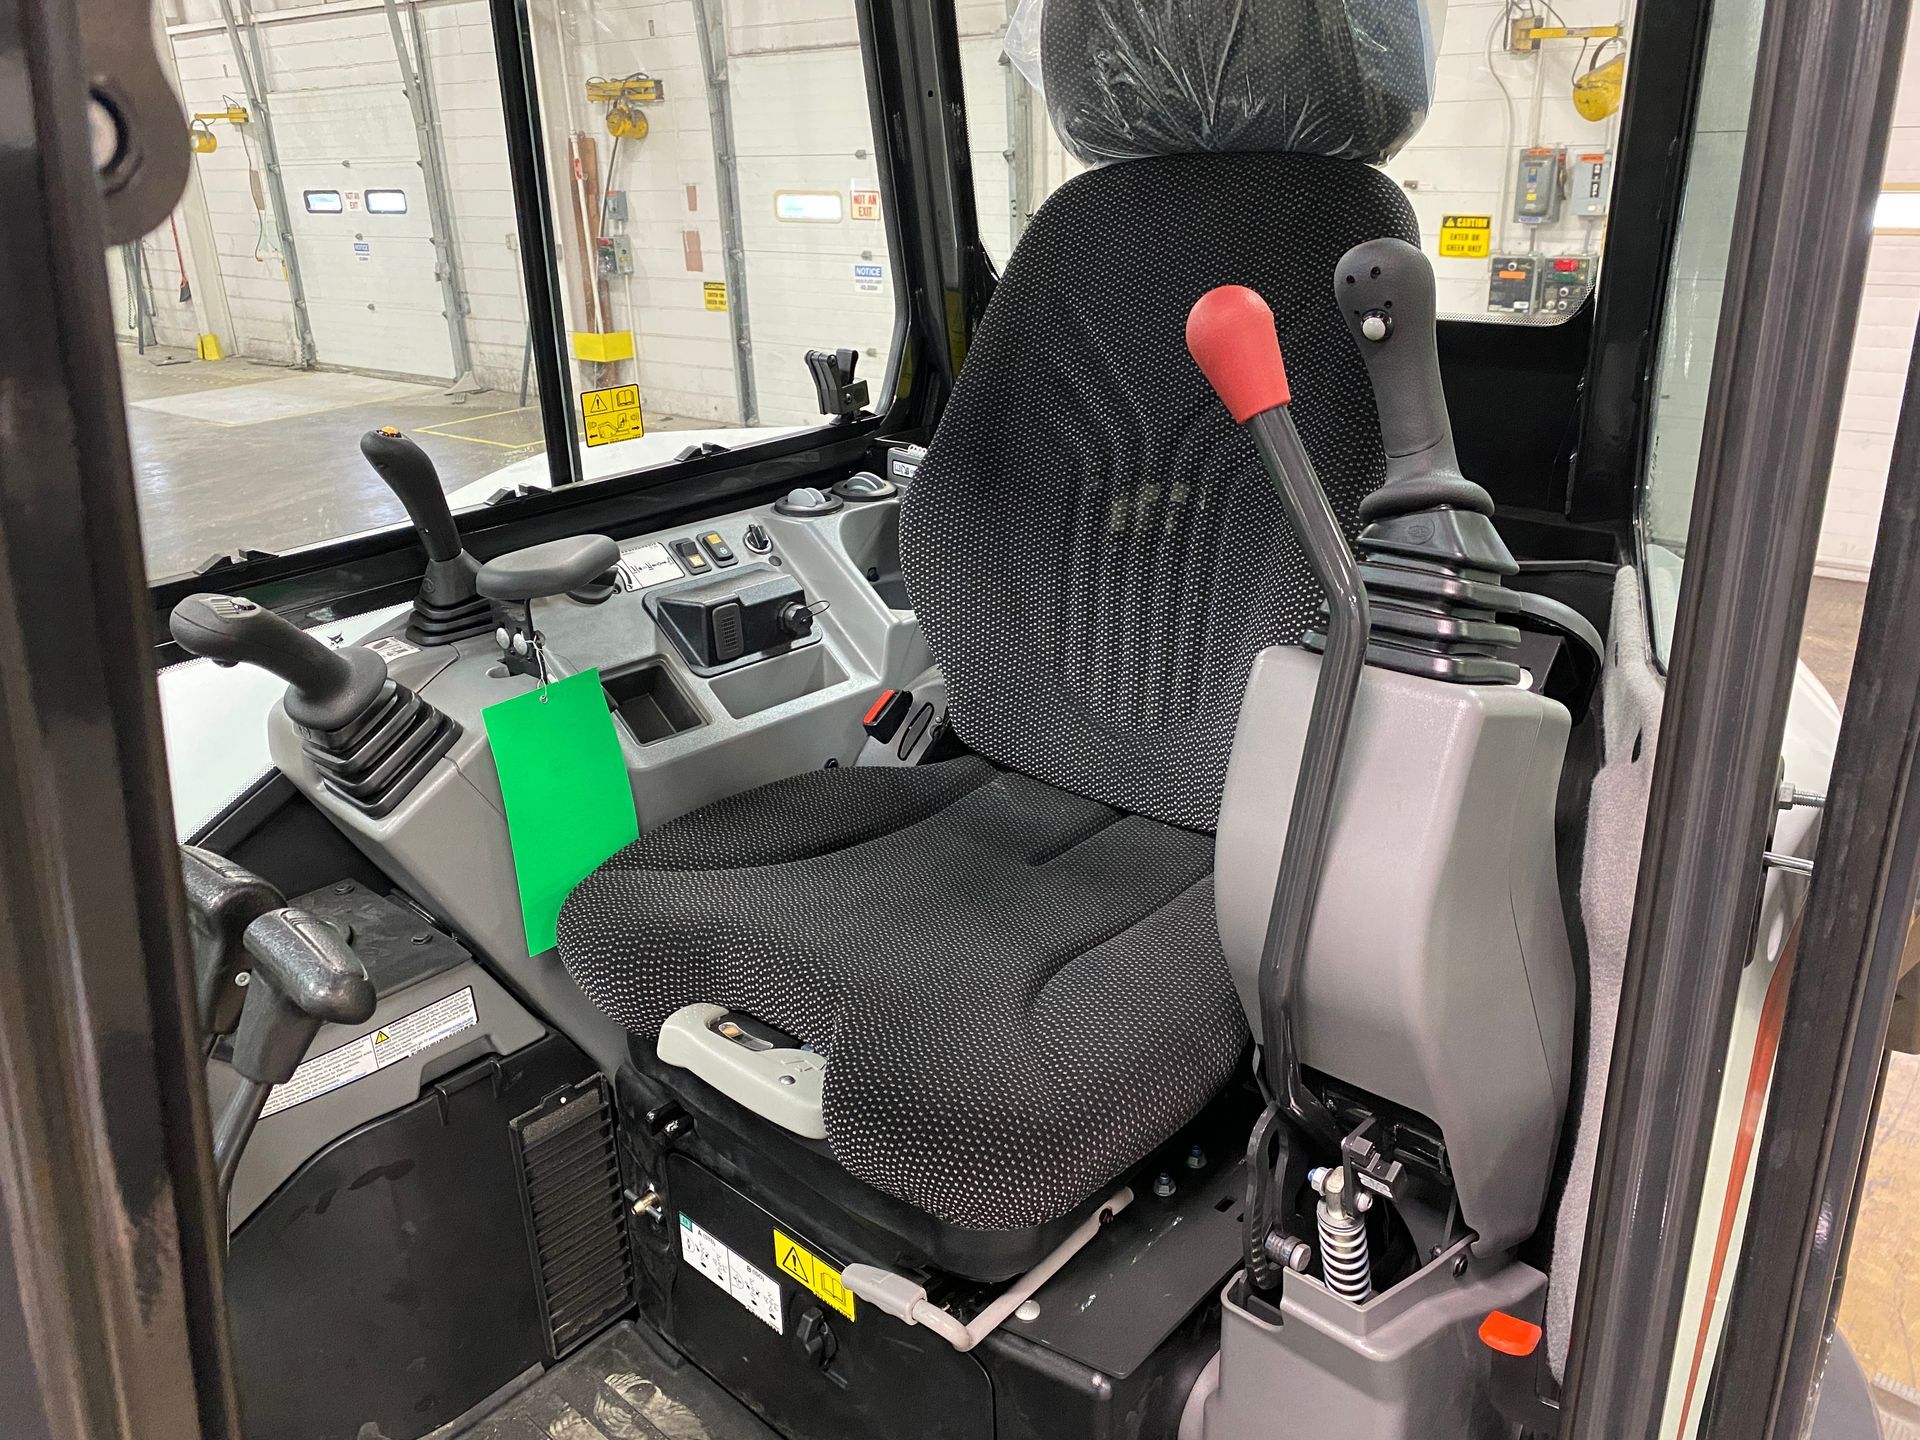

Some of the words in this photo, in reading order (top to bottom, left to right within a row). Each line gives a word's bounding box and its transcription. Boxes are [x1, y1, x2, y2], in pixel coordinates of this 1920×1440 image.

[853, 194, 866, 205] NOT
[868, 194, 877, 205] AN
[858, 206, 873, 217] EXIT
[1456, 217, 1488, 228] CAUTION
[856, 266, 881, 276] NOTICE
